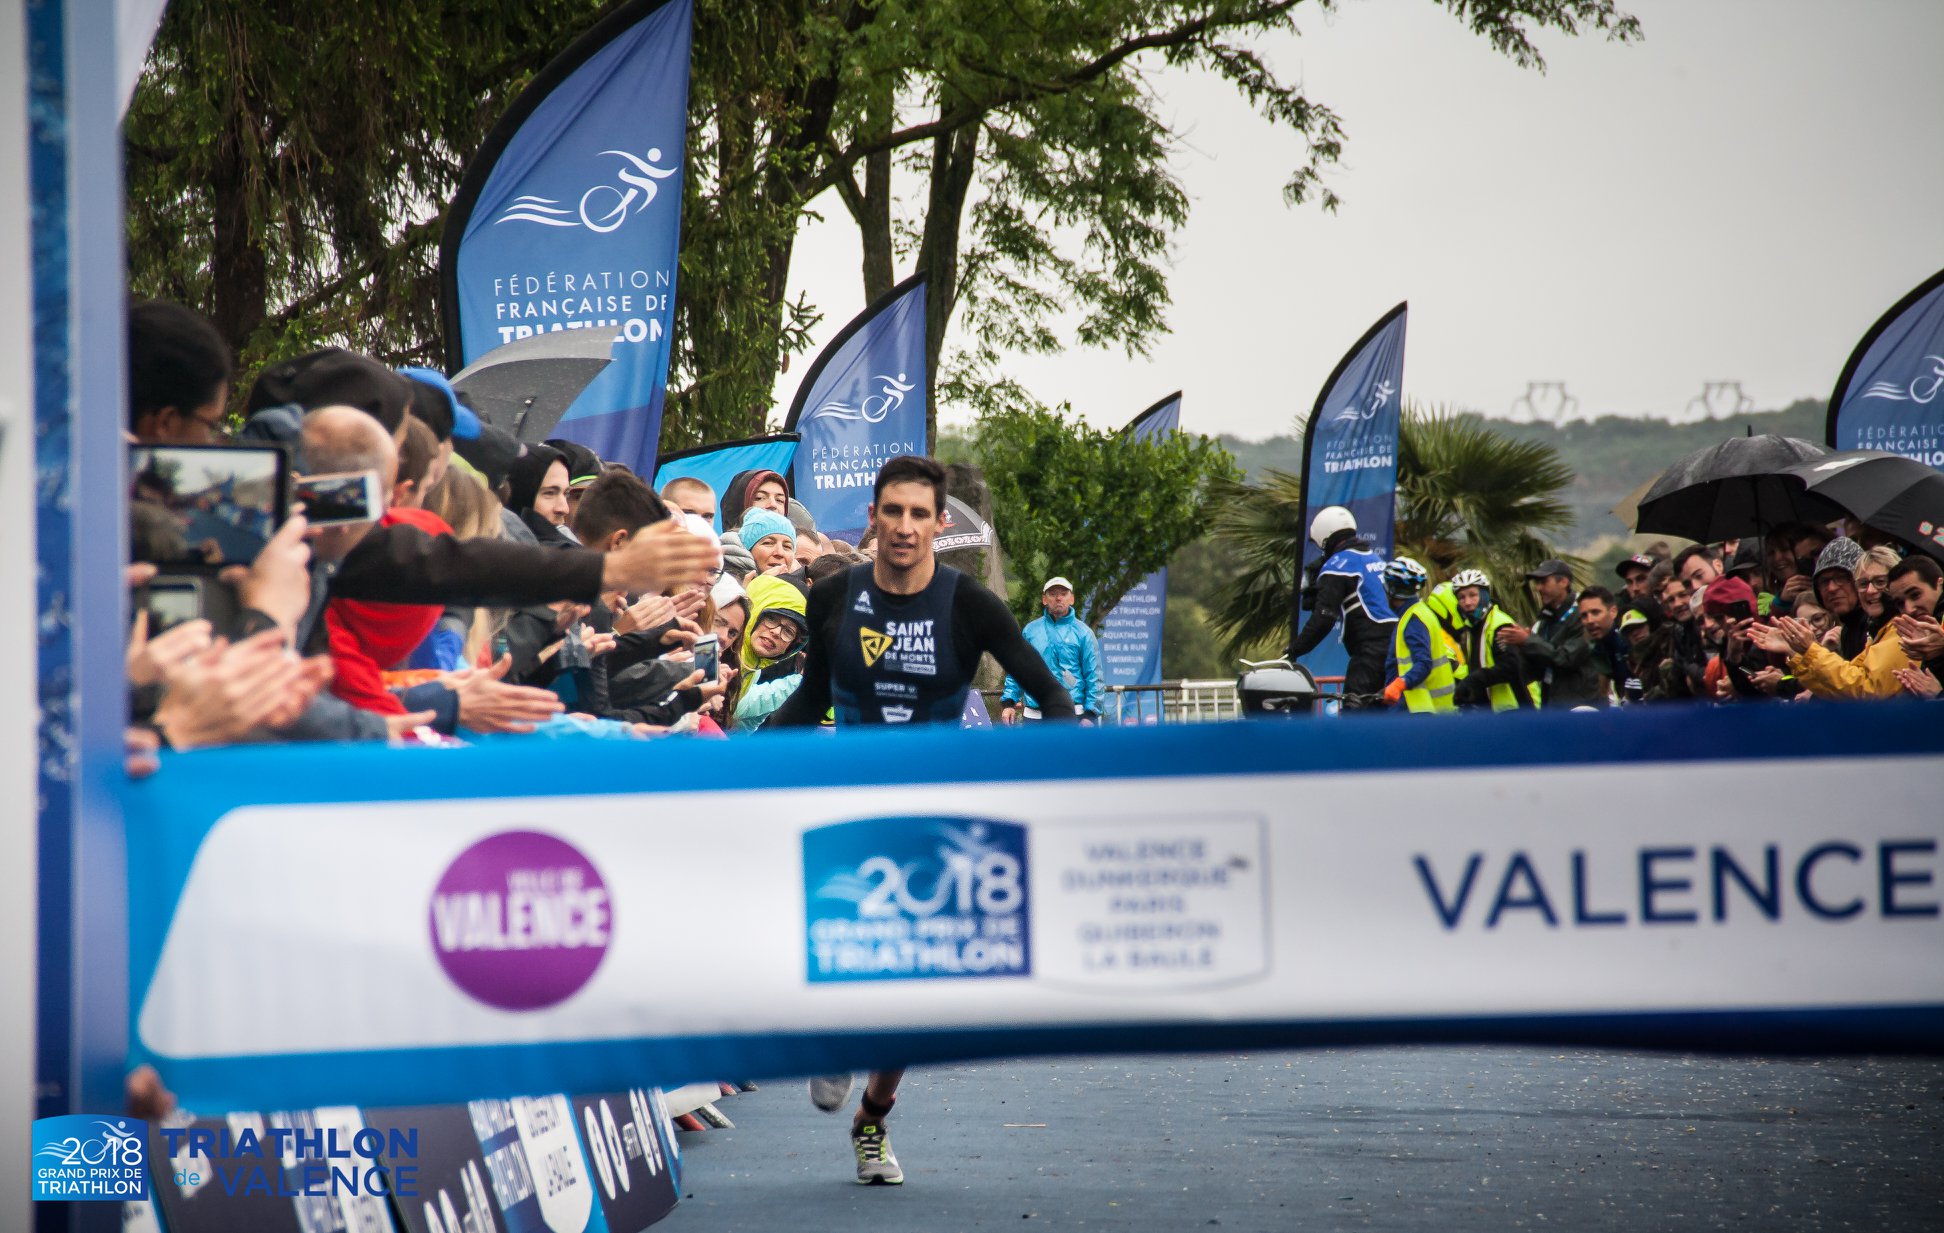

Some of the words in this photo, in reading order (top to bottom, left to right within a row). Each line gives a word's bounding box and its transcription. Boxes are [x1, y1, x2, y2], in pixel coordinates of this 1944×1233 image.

[494, 269, 670, 297] FÉDÉRATION
[496, 295, 632, 319] FRANÇAISE
[1857, 424, 1944, 440] FÉDÉRATIO
[812, 441, 914, 460] FÉDÉRATION
[1324, 455, 1393, 473] TRIATHLON
[814, 471, 877, 490] TRIATH
[886, 620, 934, 637] SAINT
[1105, 619, 1147, 628] DUATHLON
[892, 637, 935, 652] JEAN
[1102, 631, 1149, 640] AQUATHLON
[1103, 643, 1121, 652] BIKE
[1122, 643, 1129, 652] &
[1130, 643, 1148, 652] RUN
[1106, 655, 1144, 663] SWIMRUN
[1112, 667, 1137, 676] RAIDS
[855, 853, 1024, 919] 2018
[1411, 838, 1943, 933] VALENCE
[431, 888, 609, 952] VALENCE
[814, 939, 1023, 973] TRIATHLON
